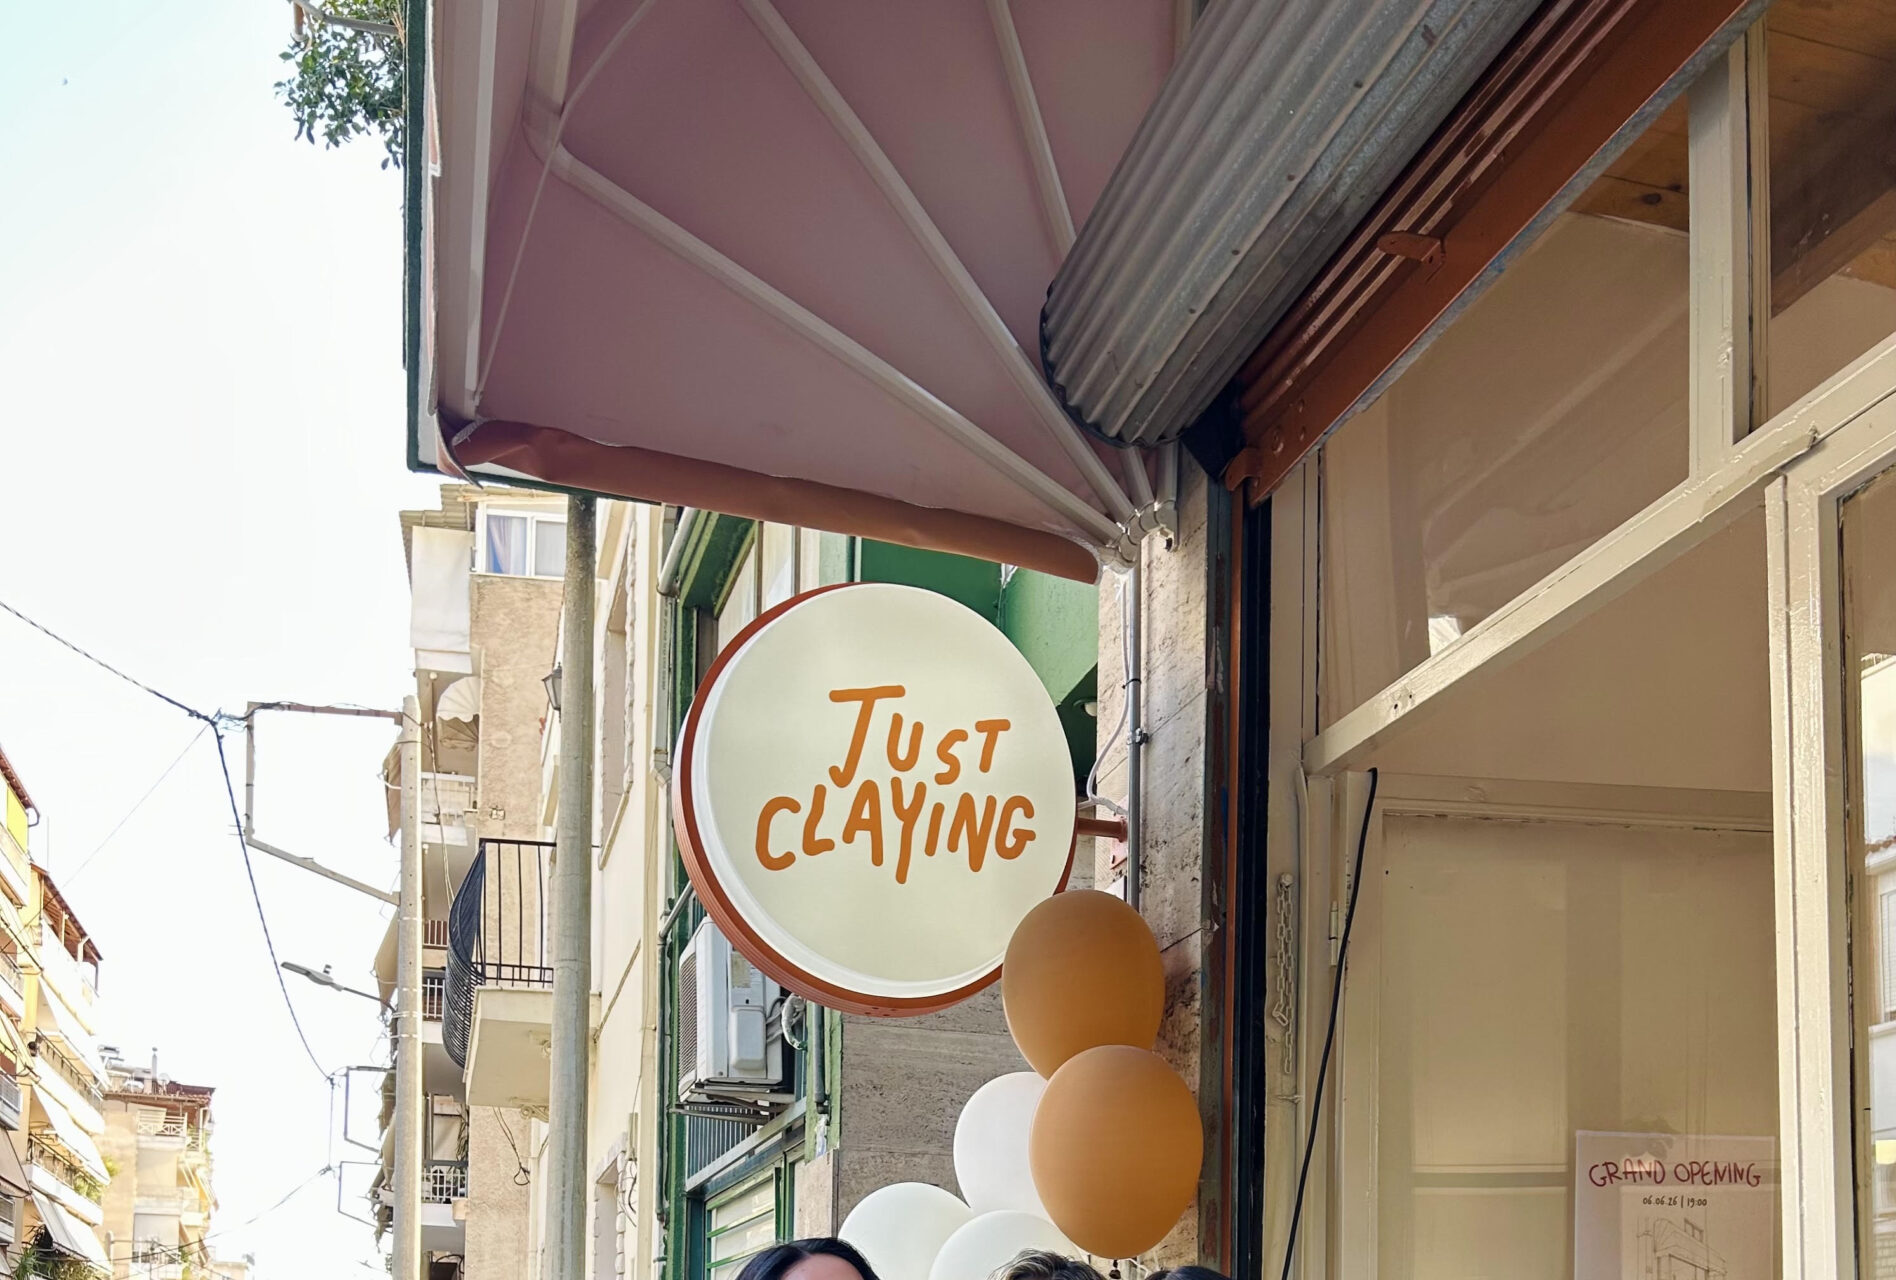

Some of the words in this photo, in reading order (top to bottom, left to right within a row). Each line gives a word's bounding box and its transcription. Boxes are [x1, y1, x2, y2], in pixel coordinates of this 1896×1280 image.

[828, 685, 1011, 789] JUST
[754, 776, 1037, 885] CLAYING
[1589, 1158, 1666, 1187] GRAND
[1673, 1160, 1762, 1188] OPENING
[1687, 1197, 1707, 1208] 19:00
